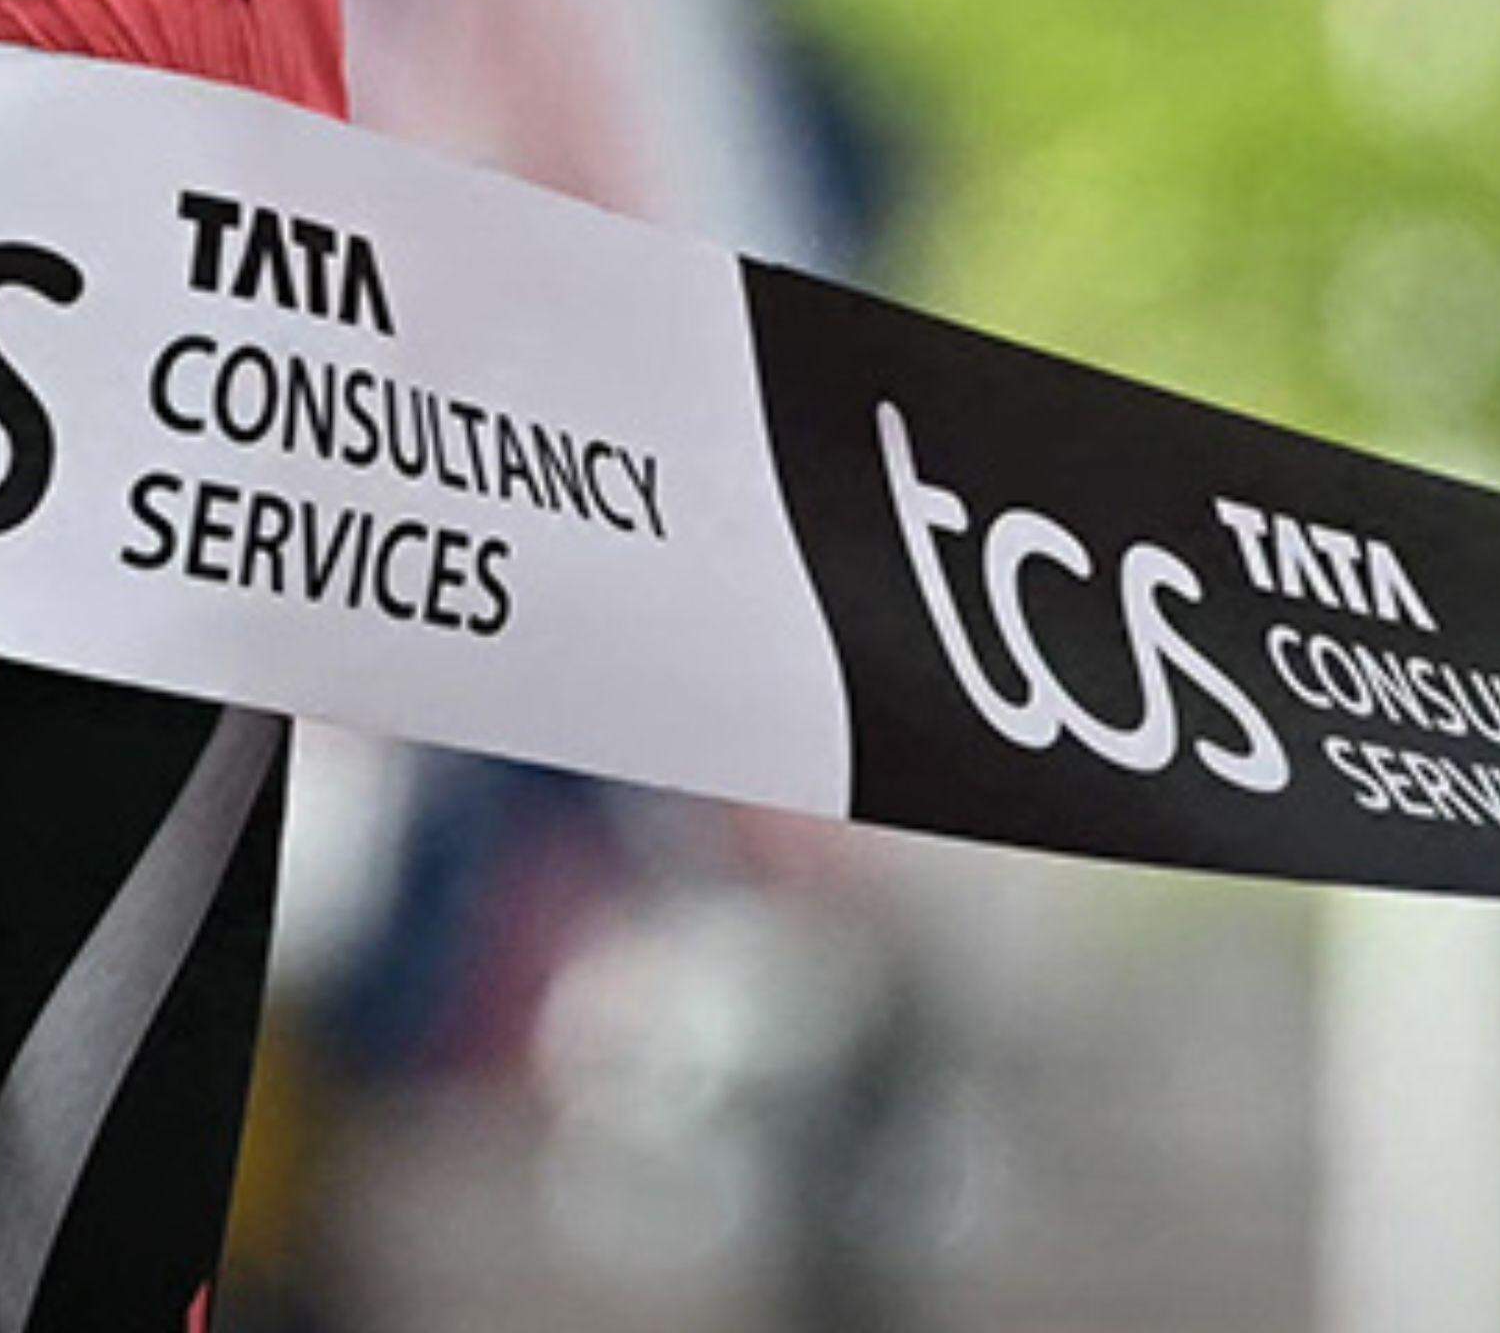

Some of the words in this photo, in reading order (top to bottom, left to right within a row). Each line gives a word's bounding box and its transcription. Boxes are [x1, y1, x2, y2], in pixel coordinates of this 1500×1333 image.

[177, 189, 396, 336] TATA
[148, 334, 669, 541] CONSULTANCY
[120, 470, 514, 638] SERVICES
[876, 398, 1290, 795] tcs
[1214, 496, 1437, 632] TATA
